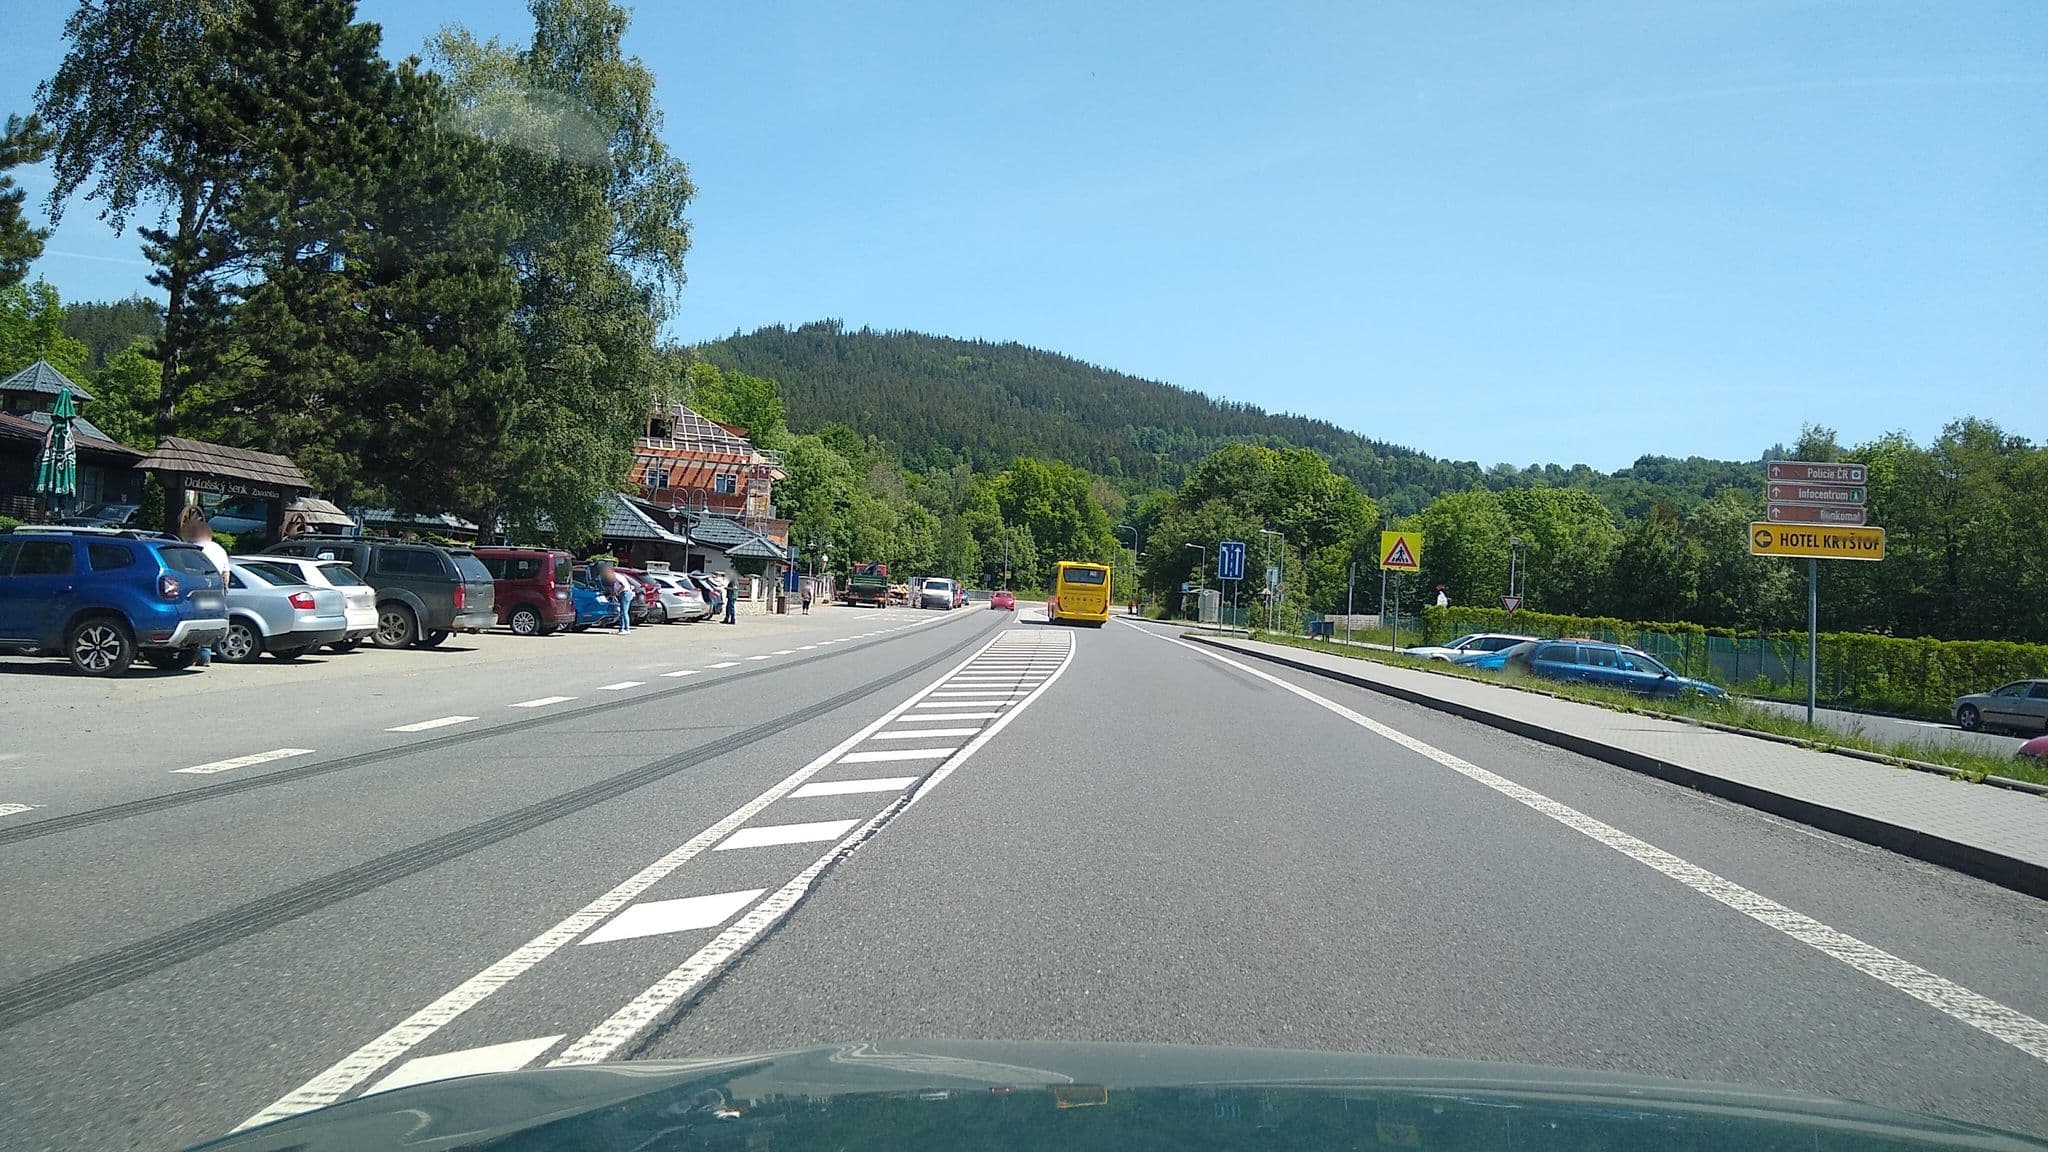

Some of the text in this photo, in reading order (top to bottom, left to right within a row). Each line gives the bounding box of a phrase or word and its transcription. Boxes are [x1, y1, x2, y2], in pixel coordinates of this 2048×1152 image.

[1807, 467, 1834, 479] Policie
[1798, 487, 1848, 500] Infocentrum
[1780, 532, 1880, 551] HOTEL KRYŠTOF
